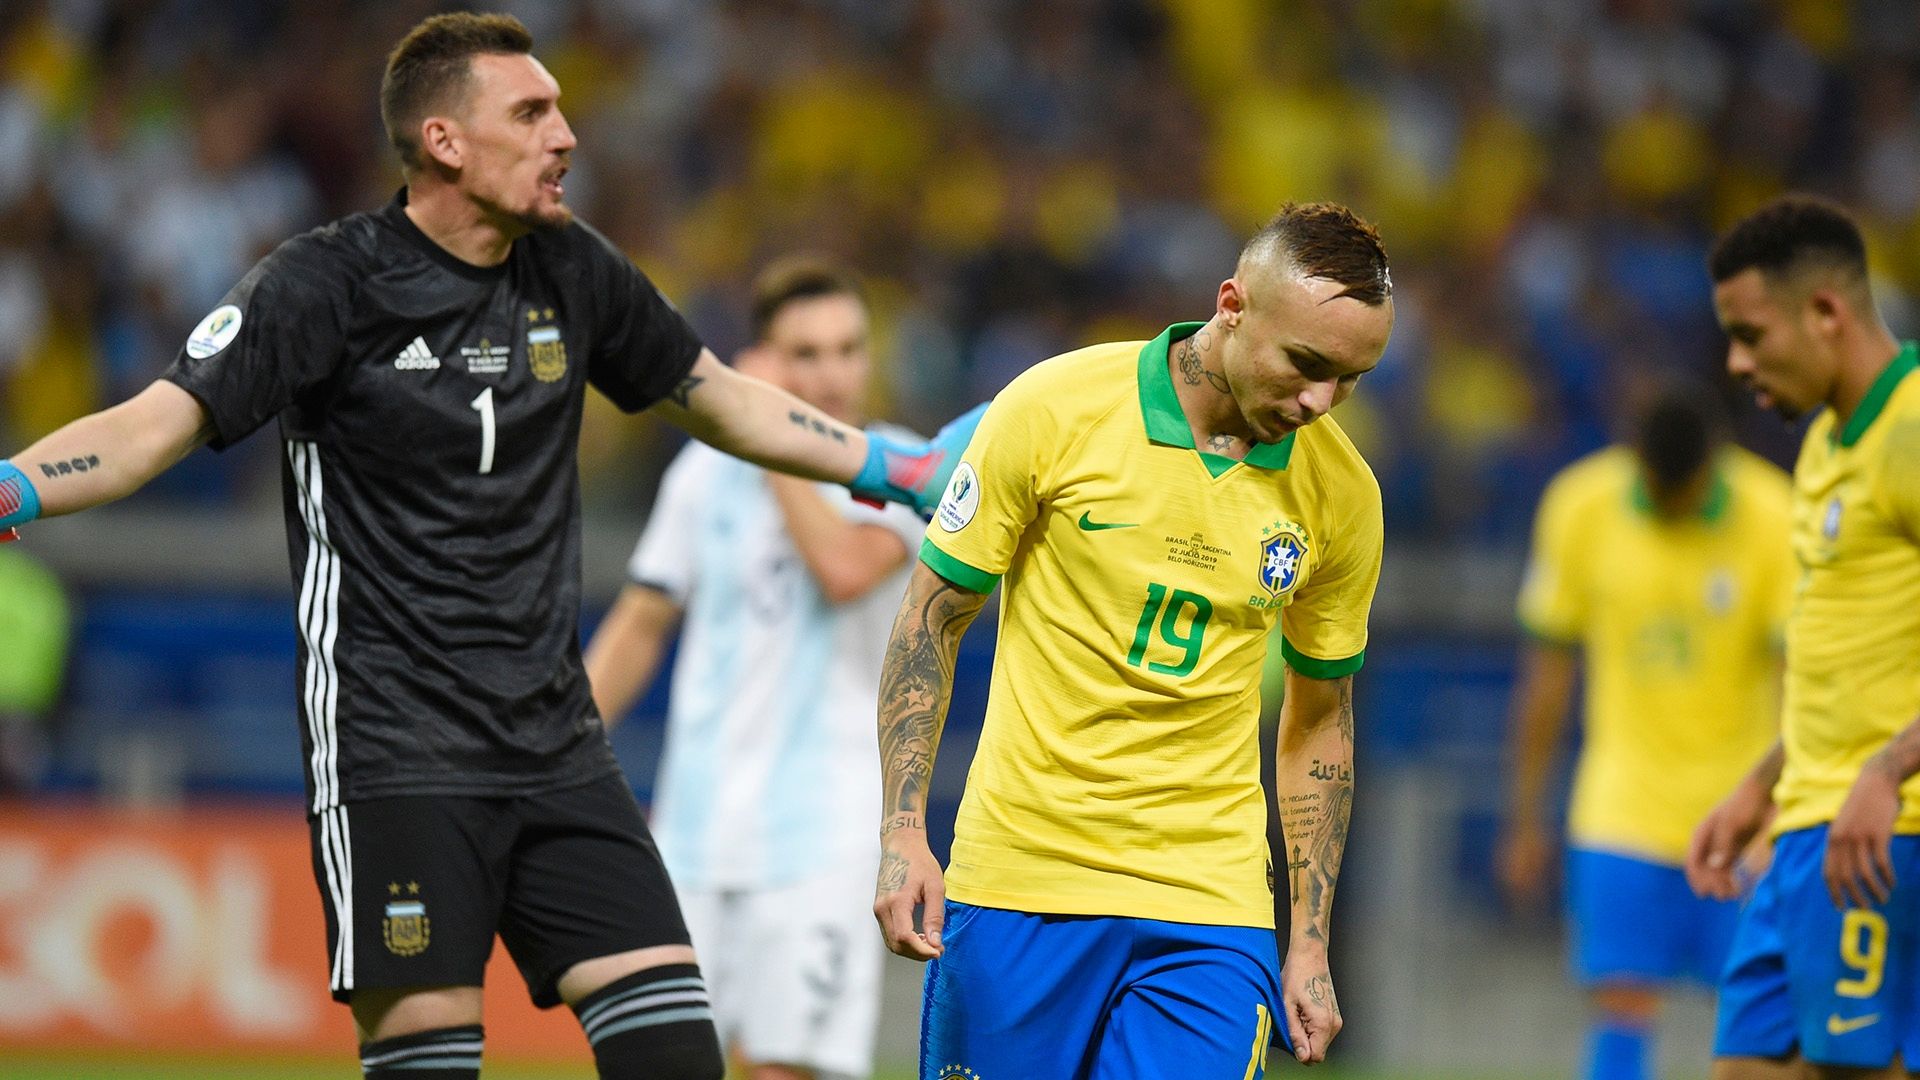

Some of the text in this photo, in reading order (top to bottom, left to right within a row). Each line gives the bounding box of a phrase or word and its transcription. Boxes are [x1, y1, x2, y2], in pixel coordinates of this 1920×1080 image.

[394, 356, 441, 370] adidas
[470, 386, 496, 475] 1
[1165, 536, 1189, 547] BRASIL
[1202, 544, 1232, 557] ARGENTINA
[1179, 549, 1200, 559] JULIO
[1201, 554, 1218, 563] 2019
[1167, 555, 1216, 572] BELO HORIZONTE
[1273, 558, 1289, 567] CBF
[1126, 581, 1214, 678] 19
[1834, 908, 1890, 999] 9
